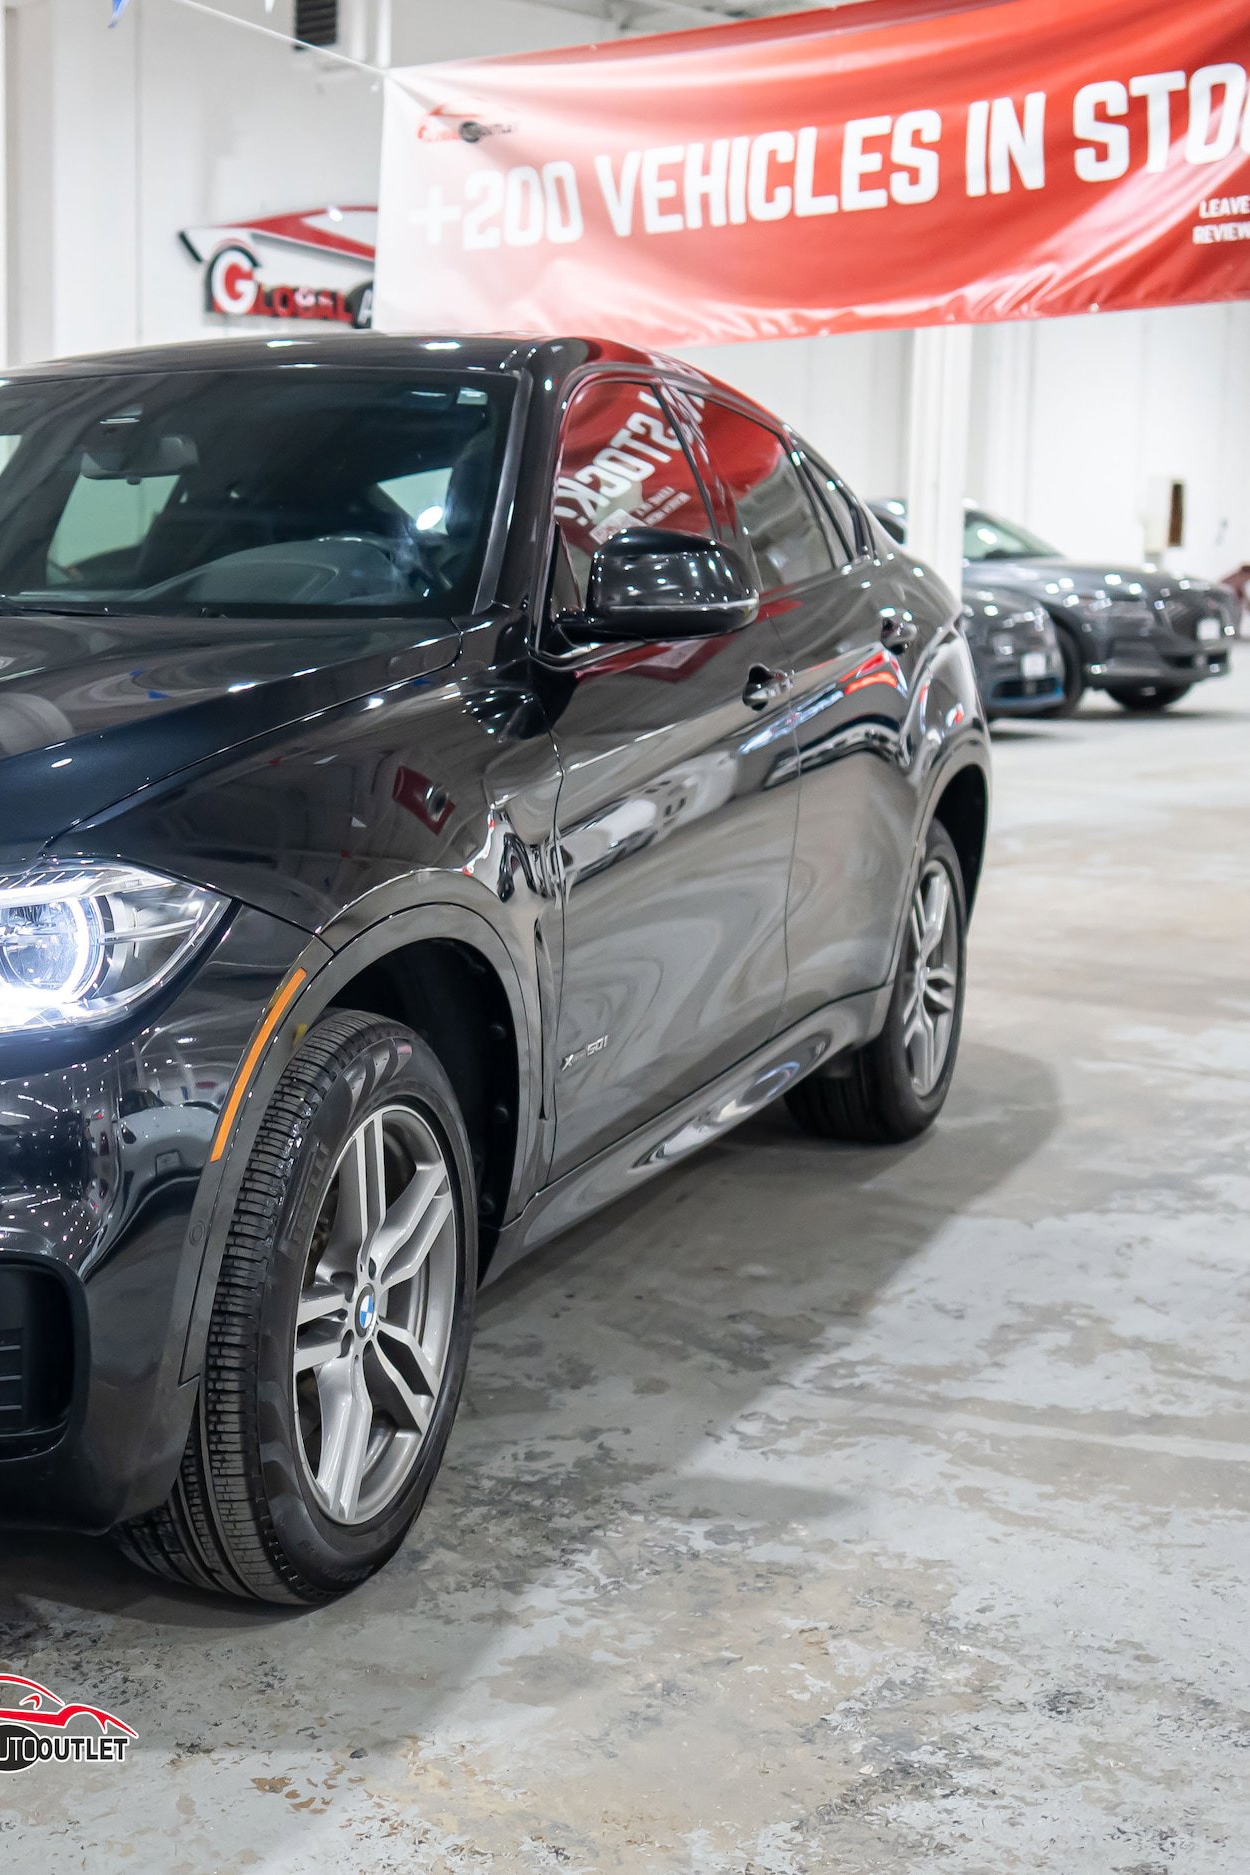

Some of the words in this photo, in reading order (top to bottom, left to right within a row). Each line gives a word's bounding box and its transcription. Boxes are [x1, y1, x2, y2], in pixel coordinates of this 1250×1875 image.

[408, 160, 584, 250] +200
[595, 111, 941, 237] VEHICLES
[966, 91, 1047, 197] IN
[1072, 62, 1250, 183] STO
[1199, 194, 1250, 219] LEAVE
